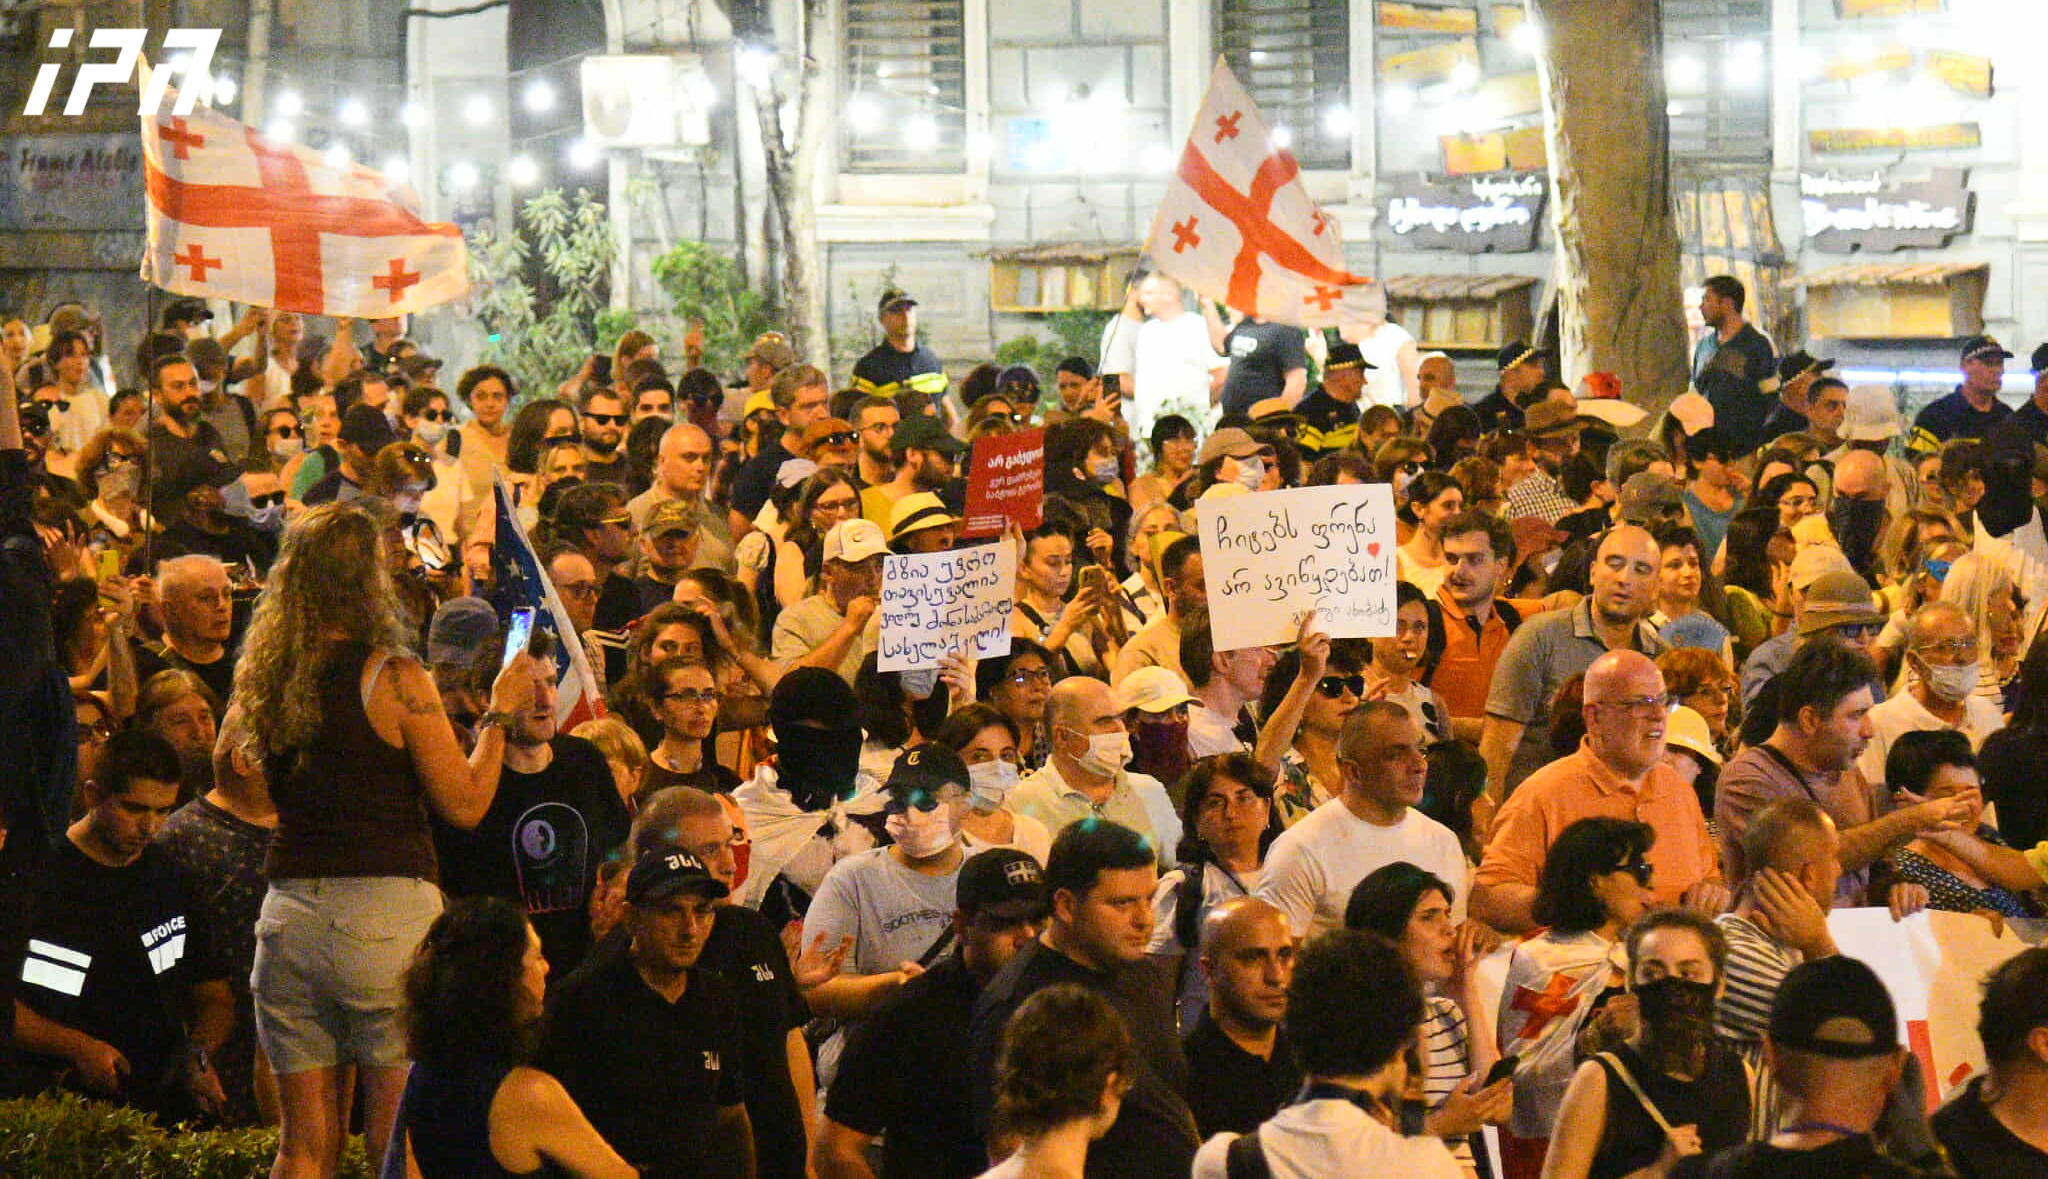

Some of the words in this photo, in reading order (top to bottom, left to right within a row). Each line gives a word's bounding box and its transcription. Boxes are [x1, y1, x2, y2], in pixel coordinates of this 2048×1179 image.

[1216, 507, 1298, 555] ჩიტებს
[1311, 500, 1376, 554] ფრენა
[887, 556, 929, 581] მზია
[1221, 567, 1251, 596] არ
[883, 572, 999, 609] თავისუფალია
